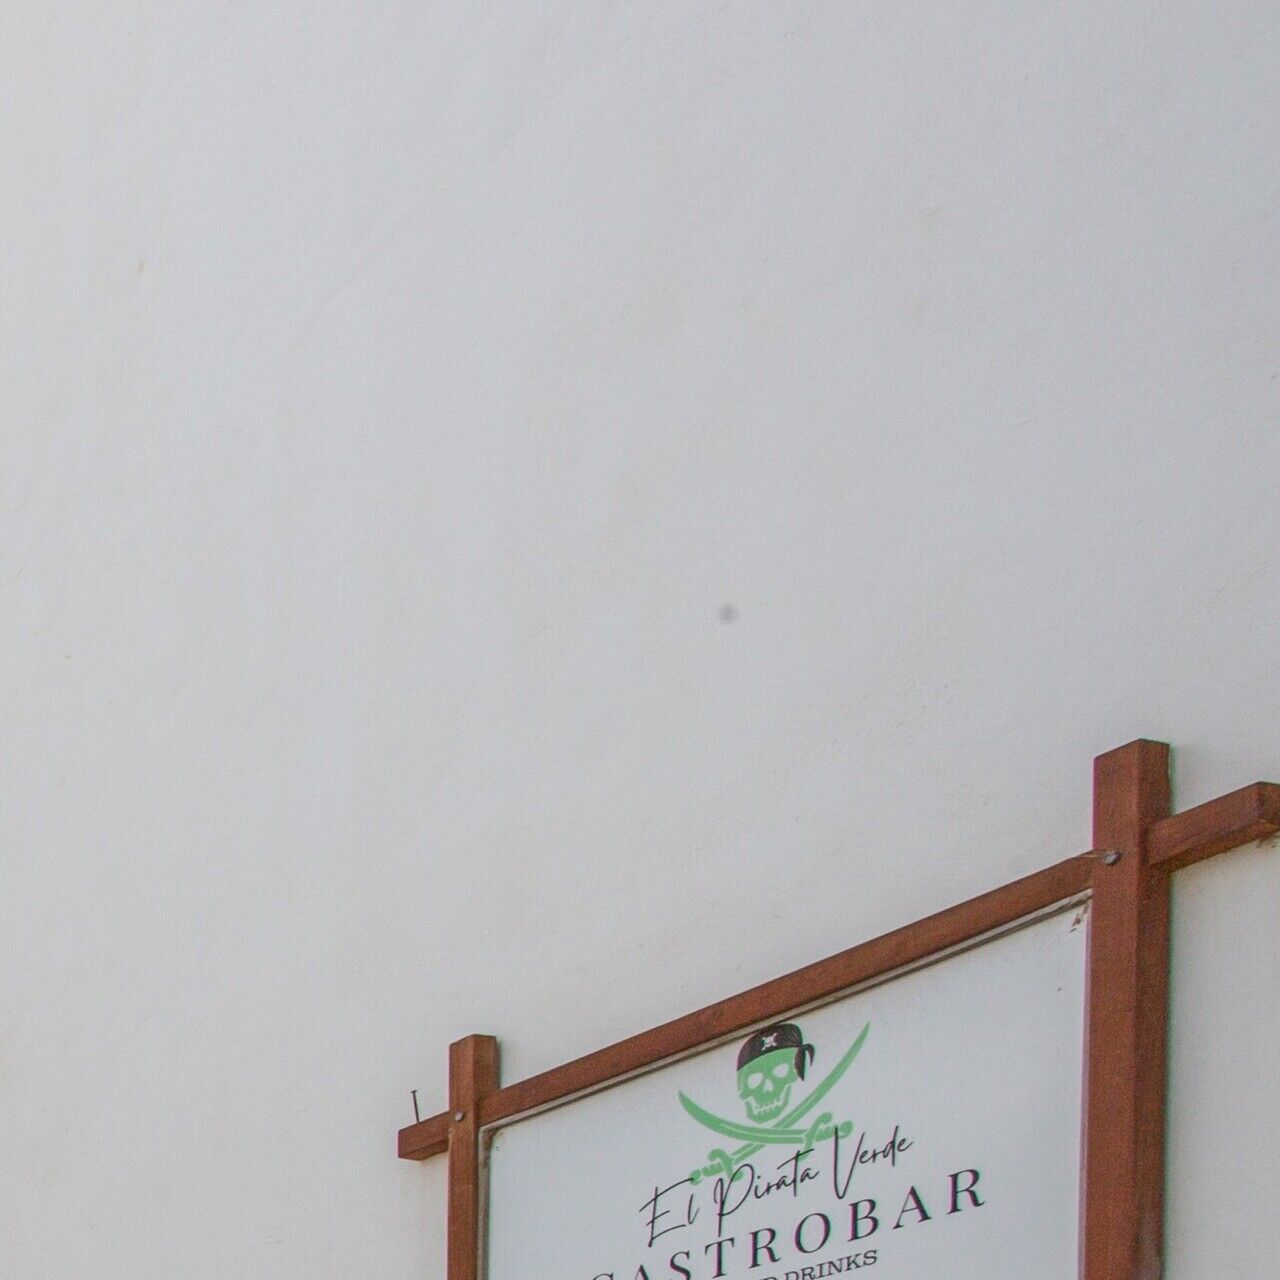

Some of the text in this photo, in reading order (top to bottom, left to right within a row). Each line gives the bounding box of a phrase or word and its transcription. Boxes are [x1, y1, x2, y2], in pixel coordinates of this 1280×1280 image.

[639, 1125, 914, 1248] El Pirata Verde
